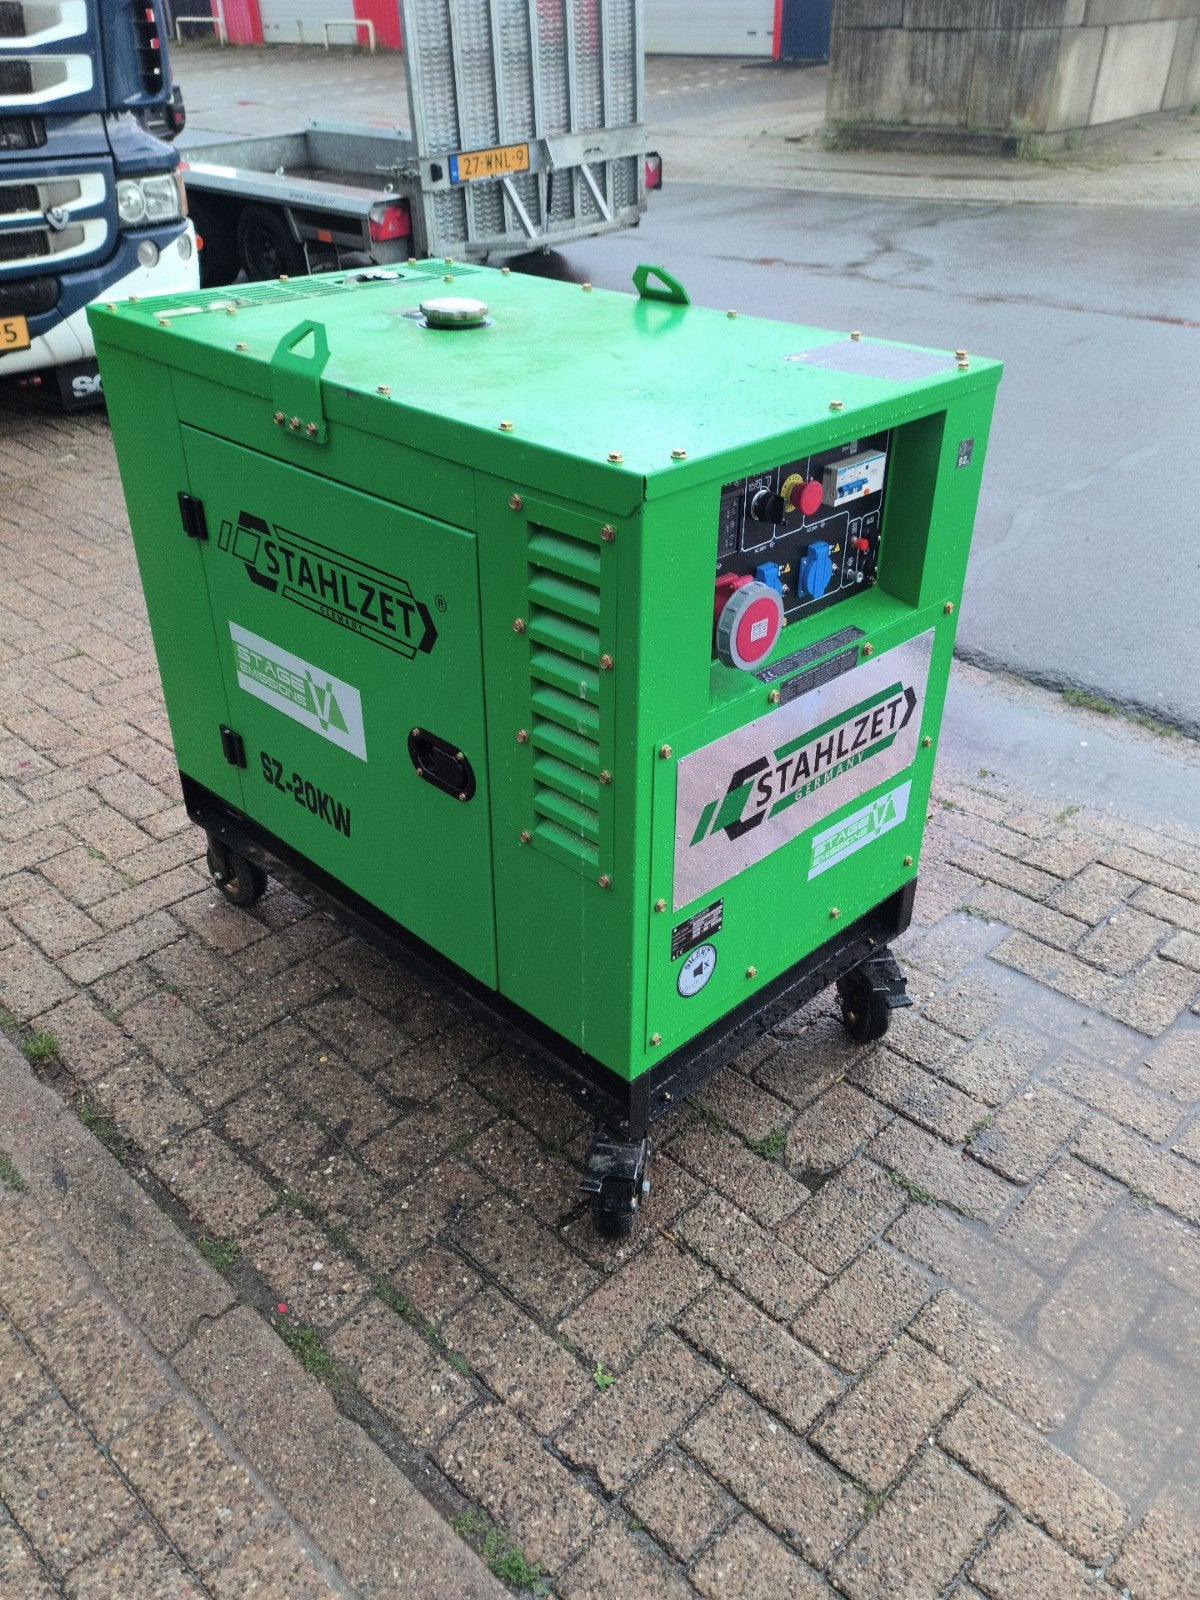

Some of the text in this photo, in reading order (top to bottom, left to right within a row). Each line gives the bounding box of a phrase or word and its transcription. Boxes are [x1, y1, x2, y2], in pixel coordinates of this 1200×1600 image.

[459, 146, 524, 176] 27-WNL-9
[263, 540, 416, 639] STAHLZET
[319, 605, 363, 633] GERMANY
[236, 645, 306, 692] STAGE
[238, 662, 308, 708] EMISSIONS
[756, 696, 903, 808] STAHLZET
[259, 750, 351, 839] SZ-20KW
[794, 750, 867, 802] GERMANY
[812, 829, 868, 866] EMISSIONS
[813, 816, 871, 856] STAGE
